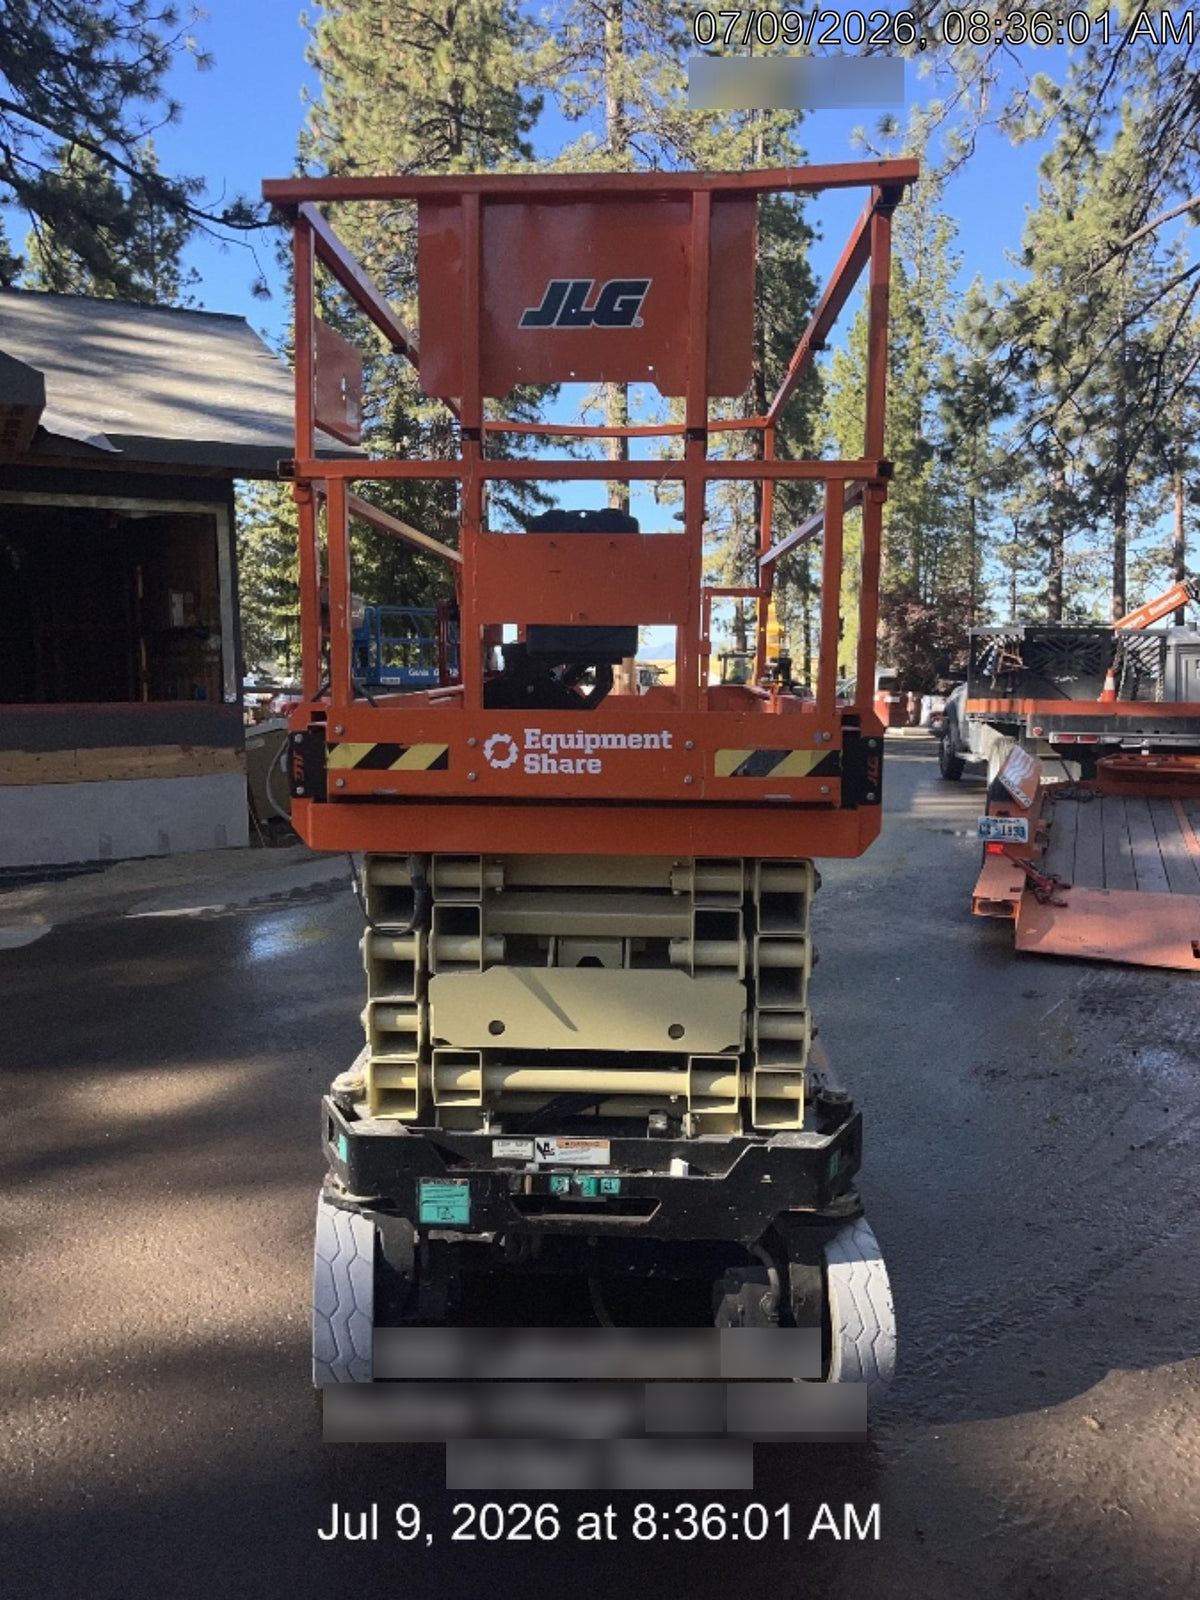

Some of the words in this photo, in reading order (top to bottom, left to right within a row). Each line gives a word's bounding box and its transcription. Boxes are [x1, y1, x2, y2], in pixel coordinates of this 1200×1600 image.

[518, 278, 652, 329] JLG
[524, 728, 674, 753] Equipment
[524, 752, 602, 775] Share
